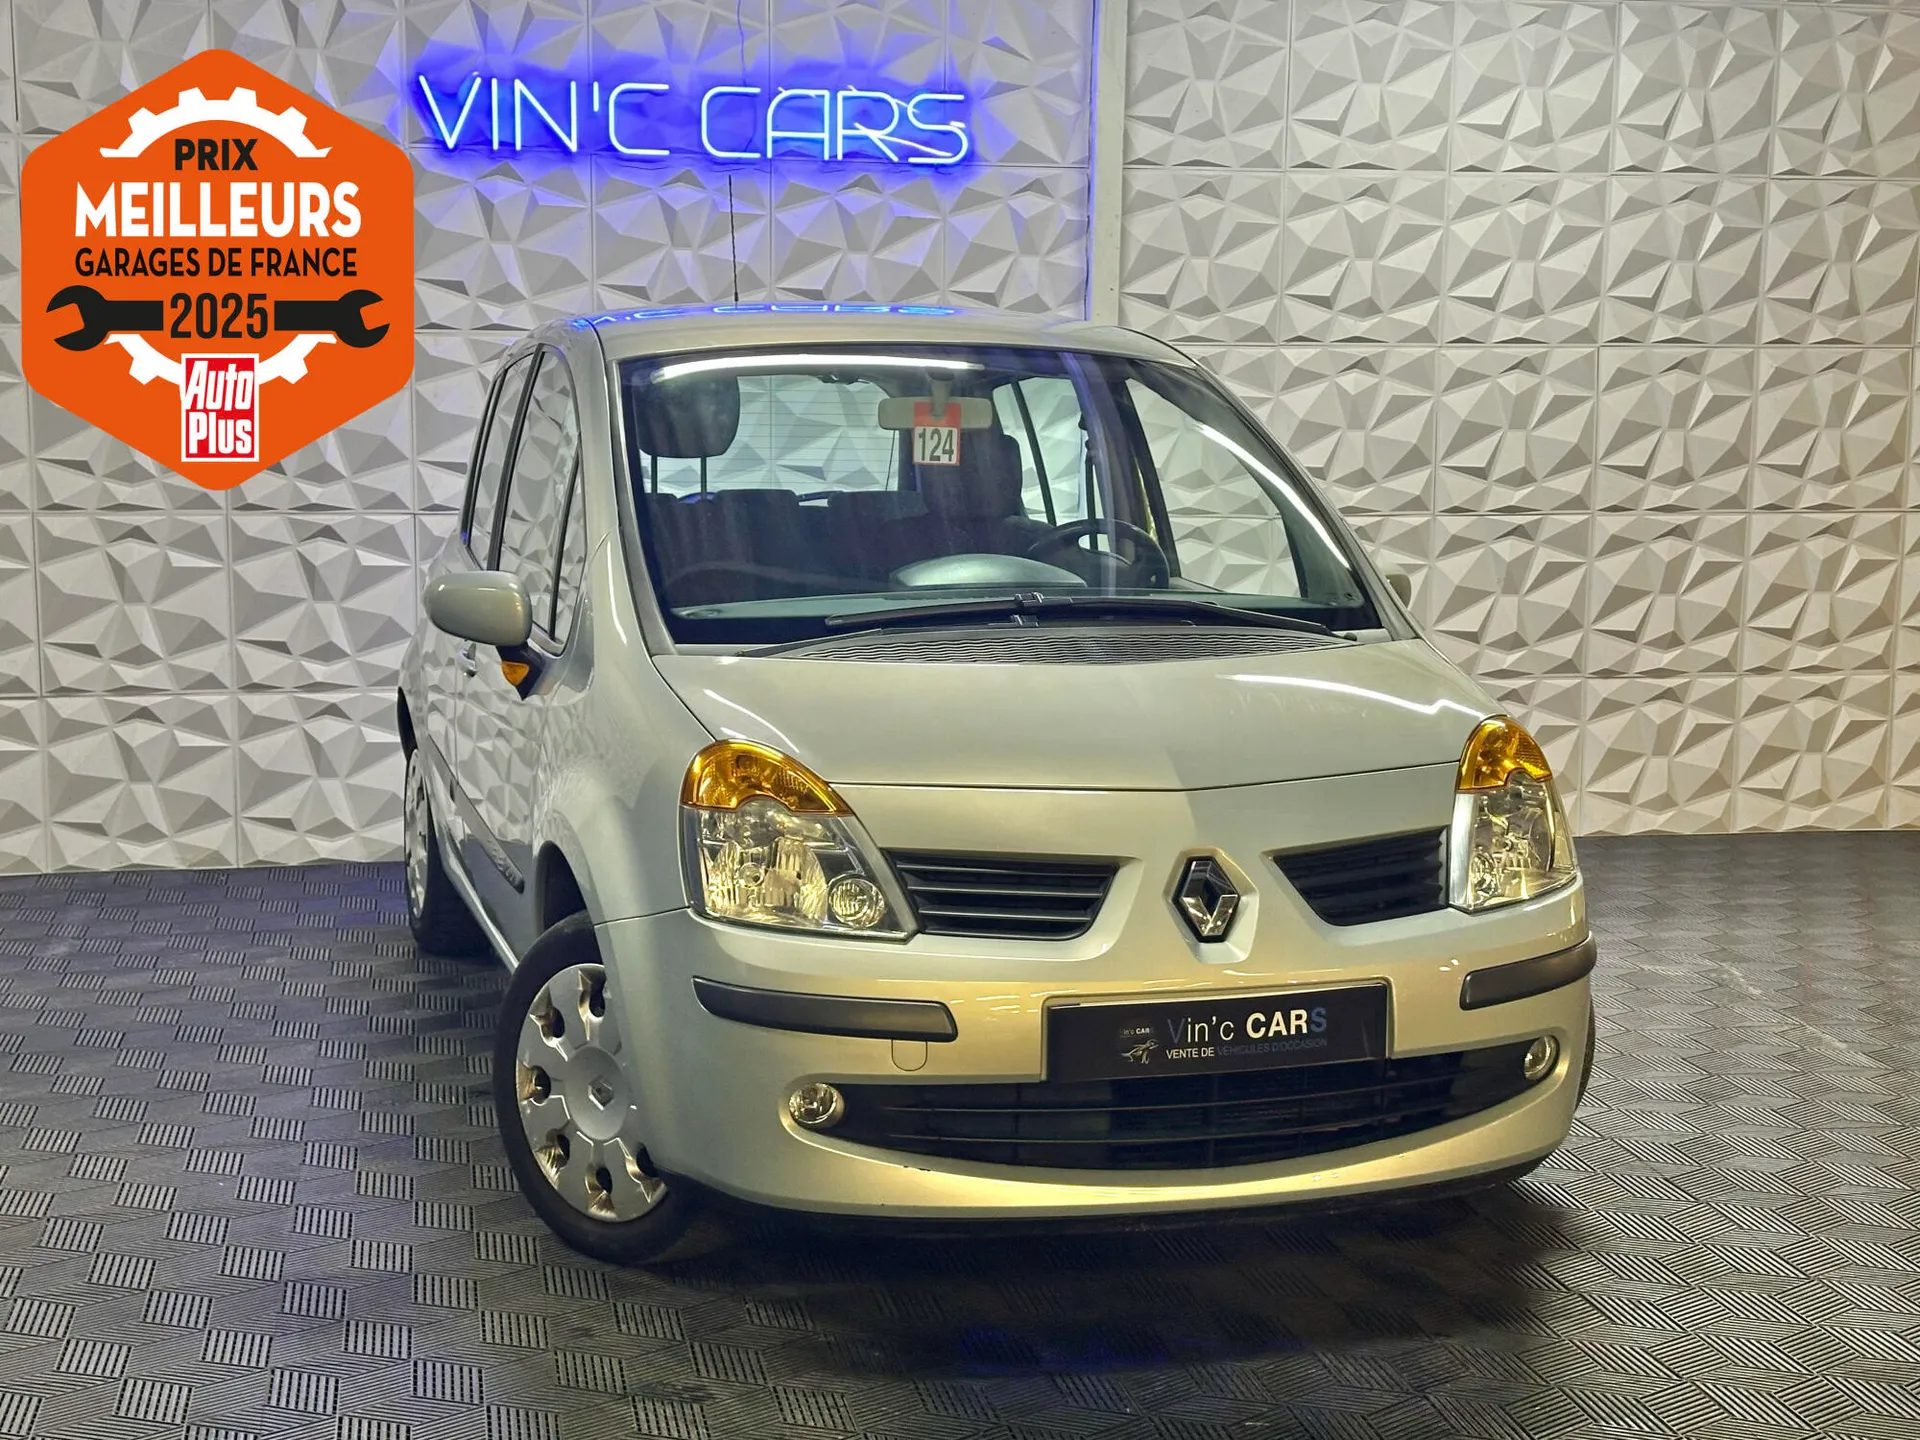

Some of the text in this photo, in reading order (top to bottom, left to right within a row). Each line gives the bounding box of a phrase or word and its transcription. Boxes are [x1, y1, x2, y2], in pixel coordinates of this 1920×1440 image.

[419, 74, 969, 164] VIN'C CARS
[918, 428, 954, 461] 124
[1168, 1008, 1327, 1044] Vin'c CARS
[1165, 1048, 1200, 1060] VENTE
[1200, 1046, 1216, 1058] DE
